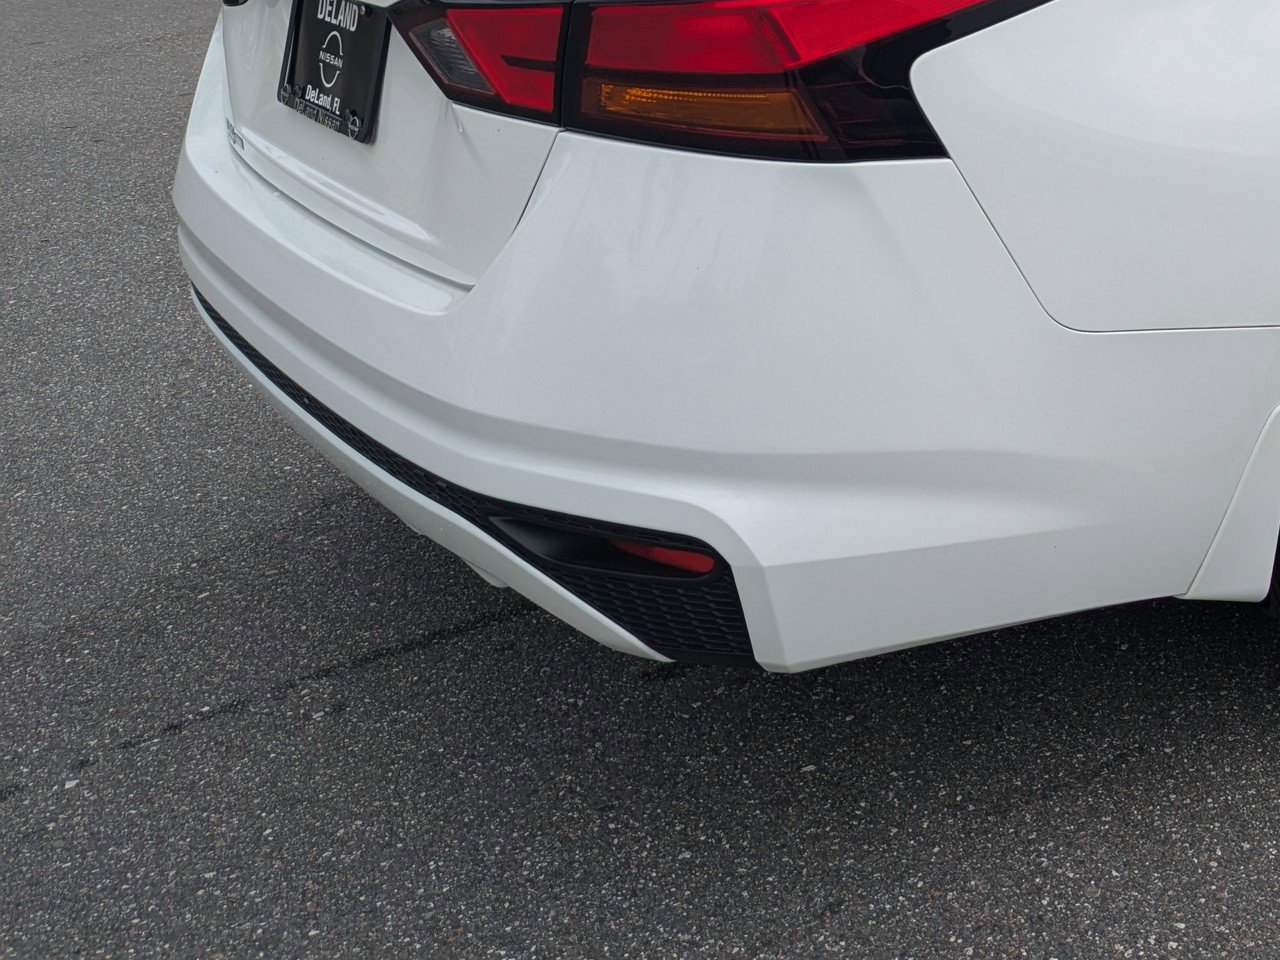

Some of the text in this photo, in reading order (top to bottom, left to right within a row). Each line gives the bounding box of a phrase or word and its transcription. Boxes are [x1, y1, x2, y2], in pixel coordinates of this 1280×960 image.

[319, 50, 344, 69] NISSAN
[294, 98, 317, 121] DeLand
[317, 110, 340, 132] Nissan
[332, 97, 341, 115] FL
